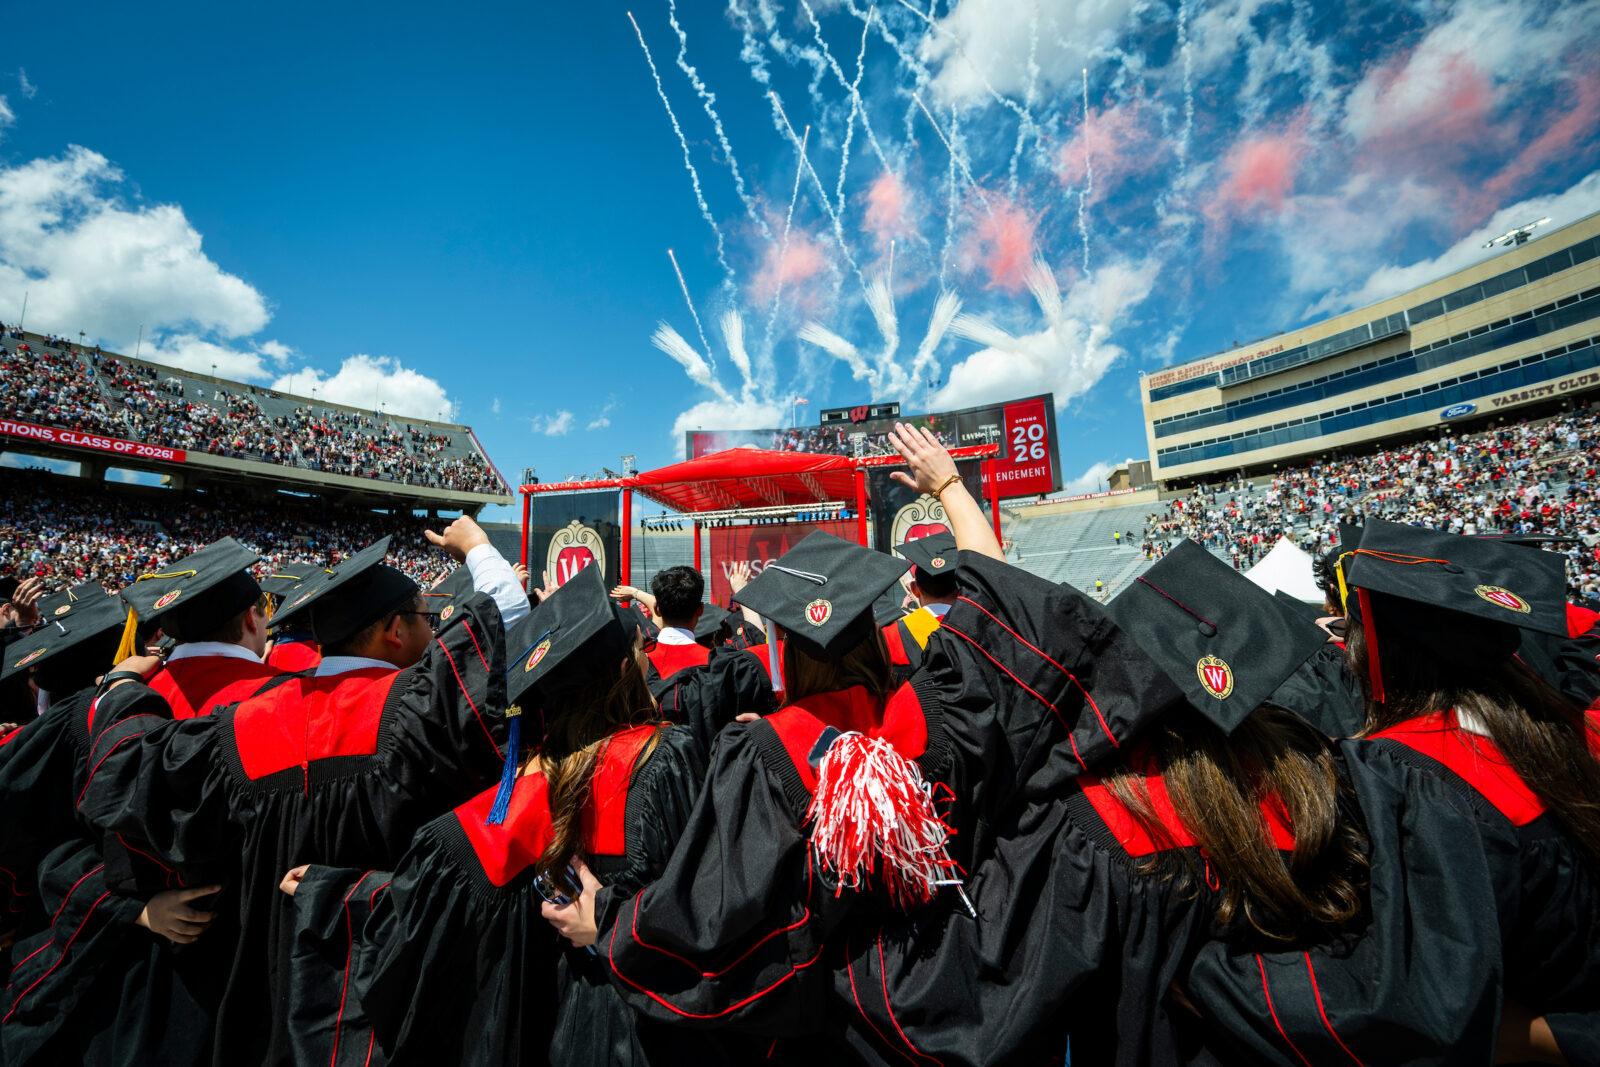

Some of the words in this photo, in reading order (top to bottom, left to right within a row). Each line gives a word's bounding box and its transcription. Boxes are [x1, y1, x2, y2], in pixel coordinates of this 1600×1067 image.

[1492, 384, 1555, 407] VARSITY
[1558, 373, 1599, 391] CLUB
[850, 405, 869, 424] W
[1015, 416, 1037, 424] SPRING
[1446, 406, 1469, 417] Ford
[1012, 424, 1044, 445] 20
[59, 432, 111, 449] CLASS
[113, 441, 135, 452] OF
[136, 445, 174, 460] 2026!
[1014, 442, 1046, 463] 26
[811, 606, 827, 621] W
[1204, 667, 1225, 690] W
